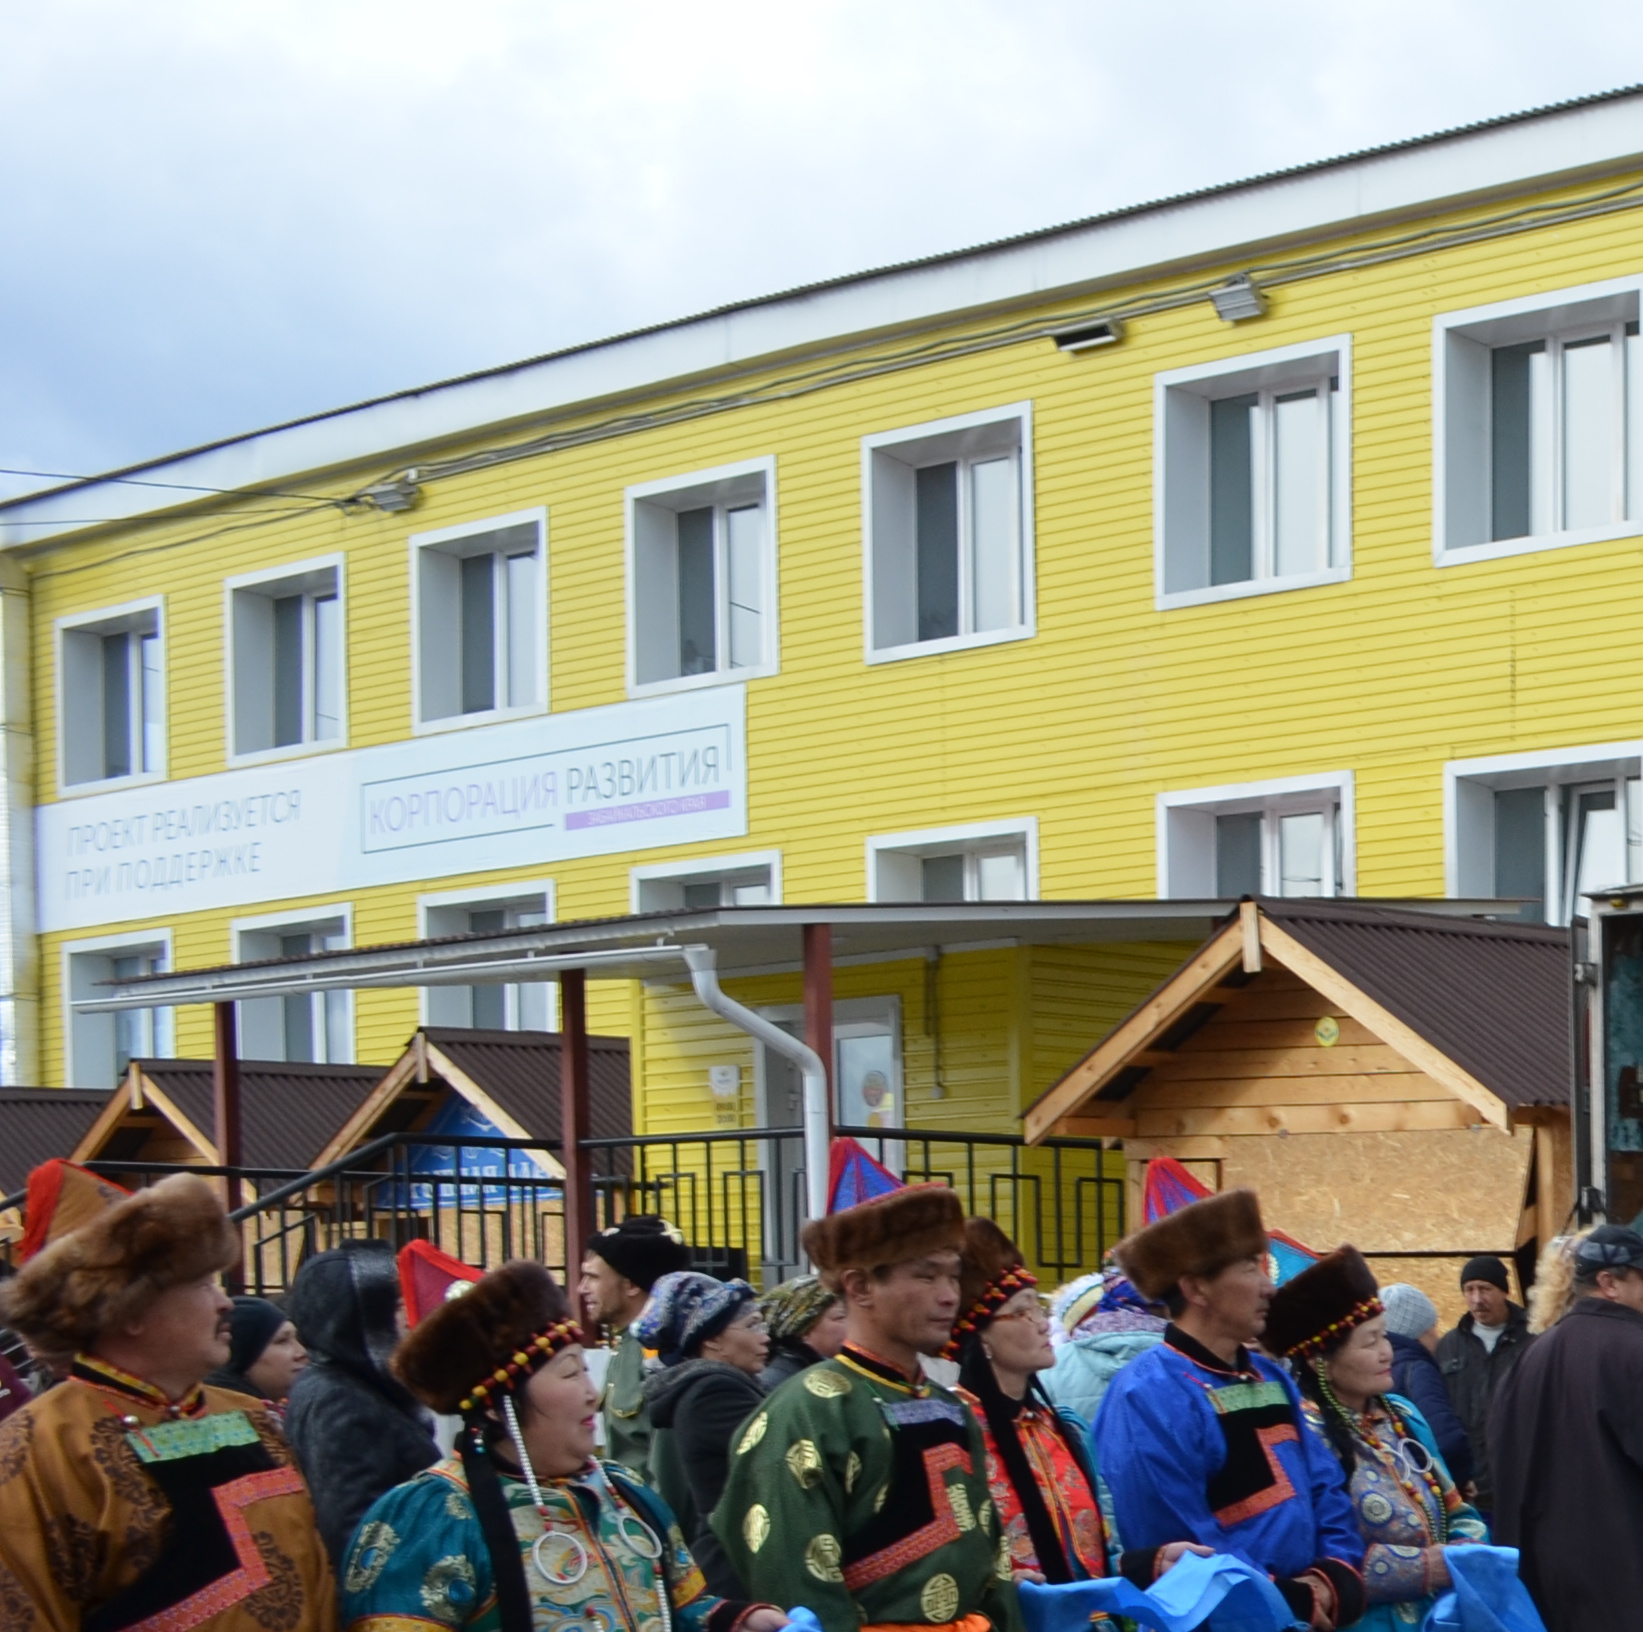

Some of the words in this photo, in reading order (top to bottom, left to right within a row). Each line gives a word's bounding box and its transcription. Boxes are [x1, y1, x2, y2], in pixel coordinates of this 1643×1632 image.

[66, 814, 148, 857] ПРОЕКТ
[151, 789, 301, 842] РЕАЛИЗУЕТСЯ
[370, 771, 558, 834] КОРПОРАЦИЯ
[567, 746, 719, 804] РАЗВИТИЯ
[64, 867, 110, 900] ПРИ
[116, 842, 262, 892] ПОДДЕРЖКЕ
